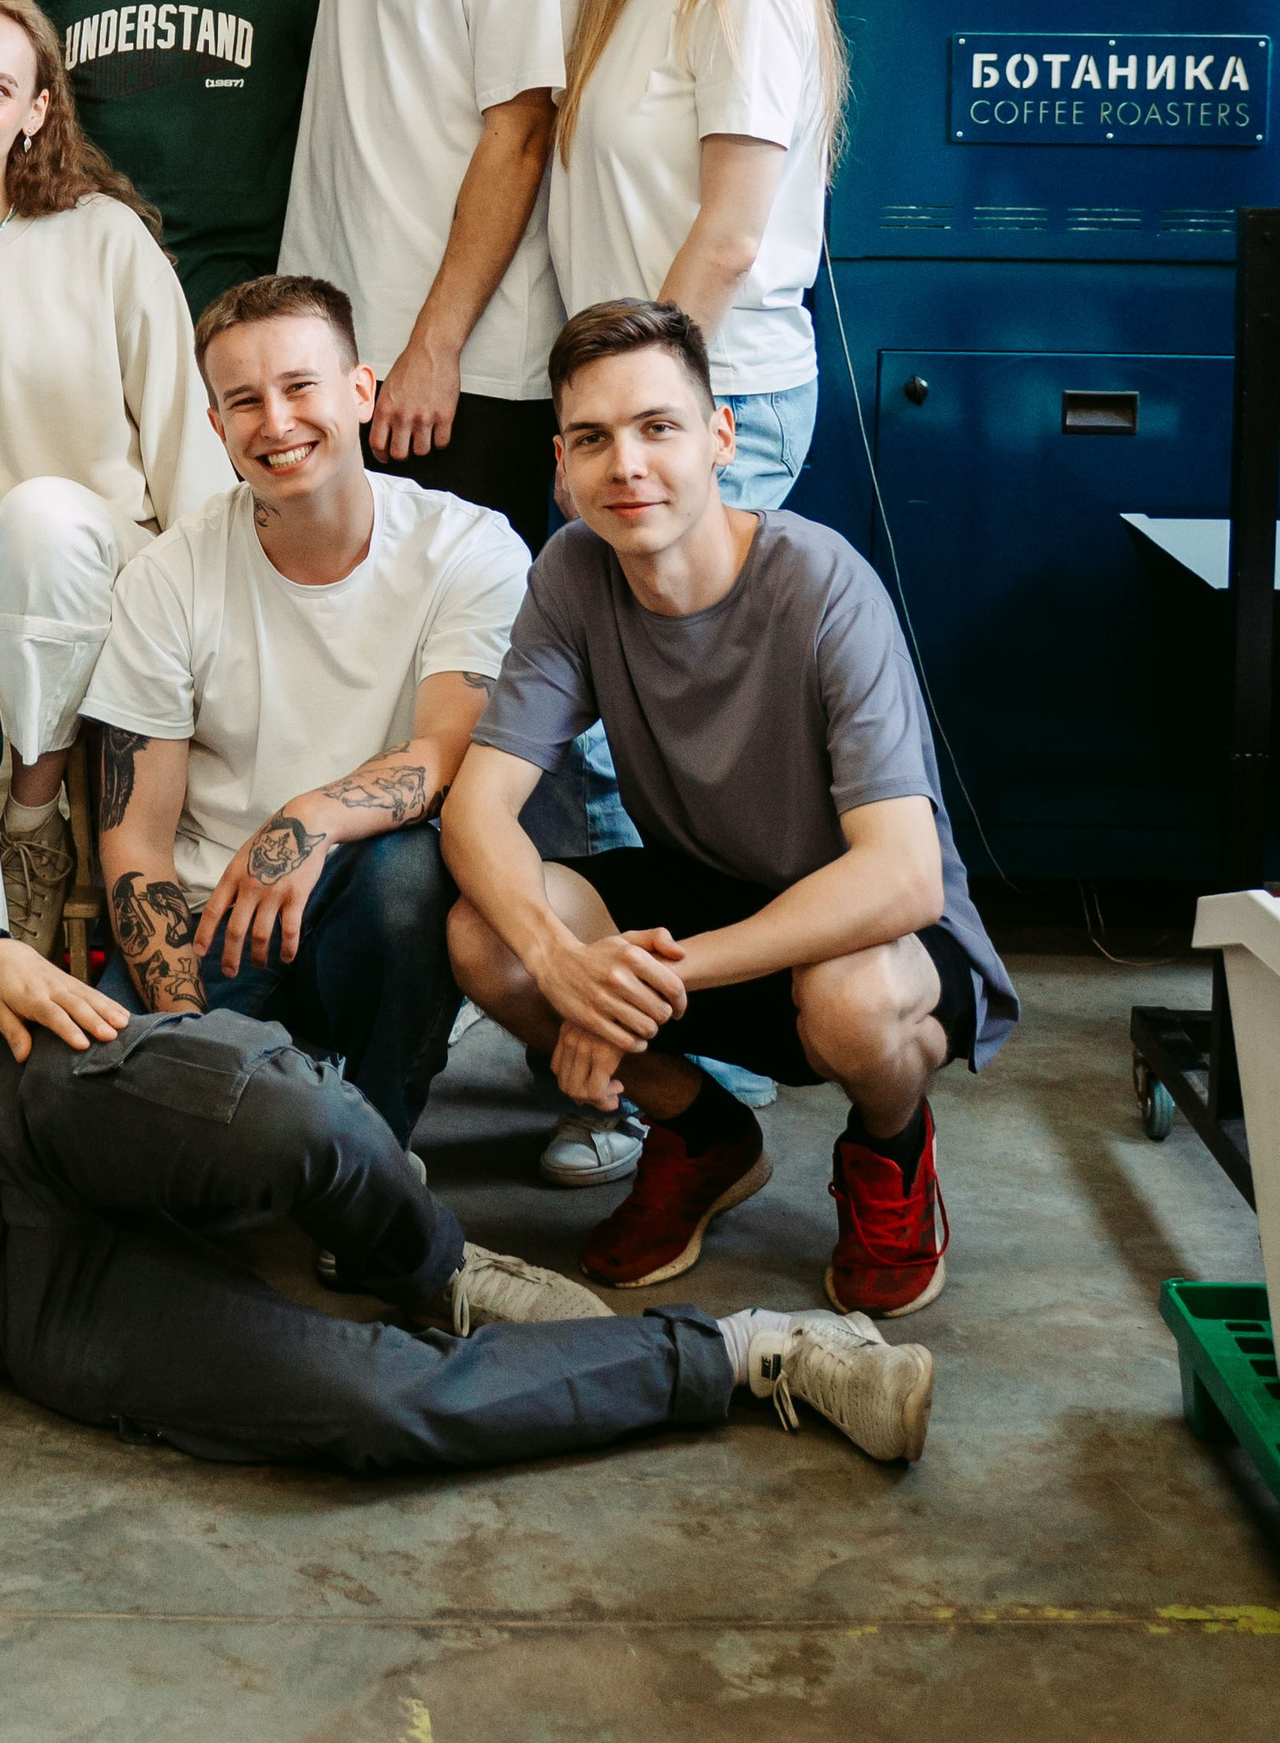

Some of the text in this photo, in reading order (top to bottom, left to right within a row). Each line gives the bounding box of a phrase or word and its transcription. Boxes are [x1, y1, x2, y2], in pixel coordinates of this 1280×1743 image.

[65, 3, 254, 70] UNDERSTAND
[971, 52, 1250, 91] БОТАНИКА
[969, 99, 1250, 127] COFFEE ROASTERS
